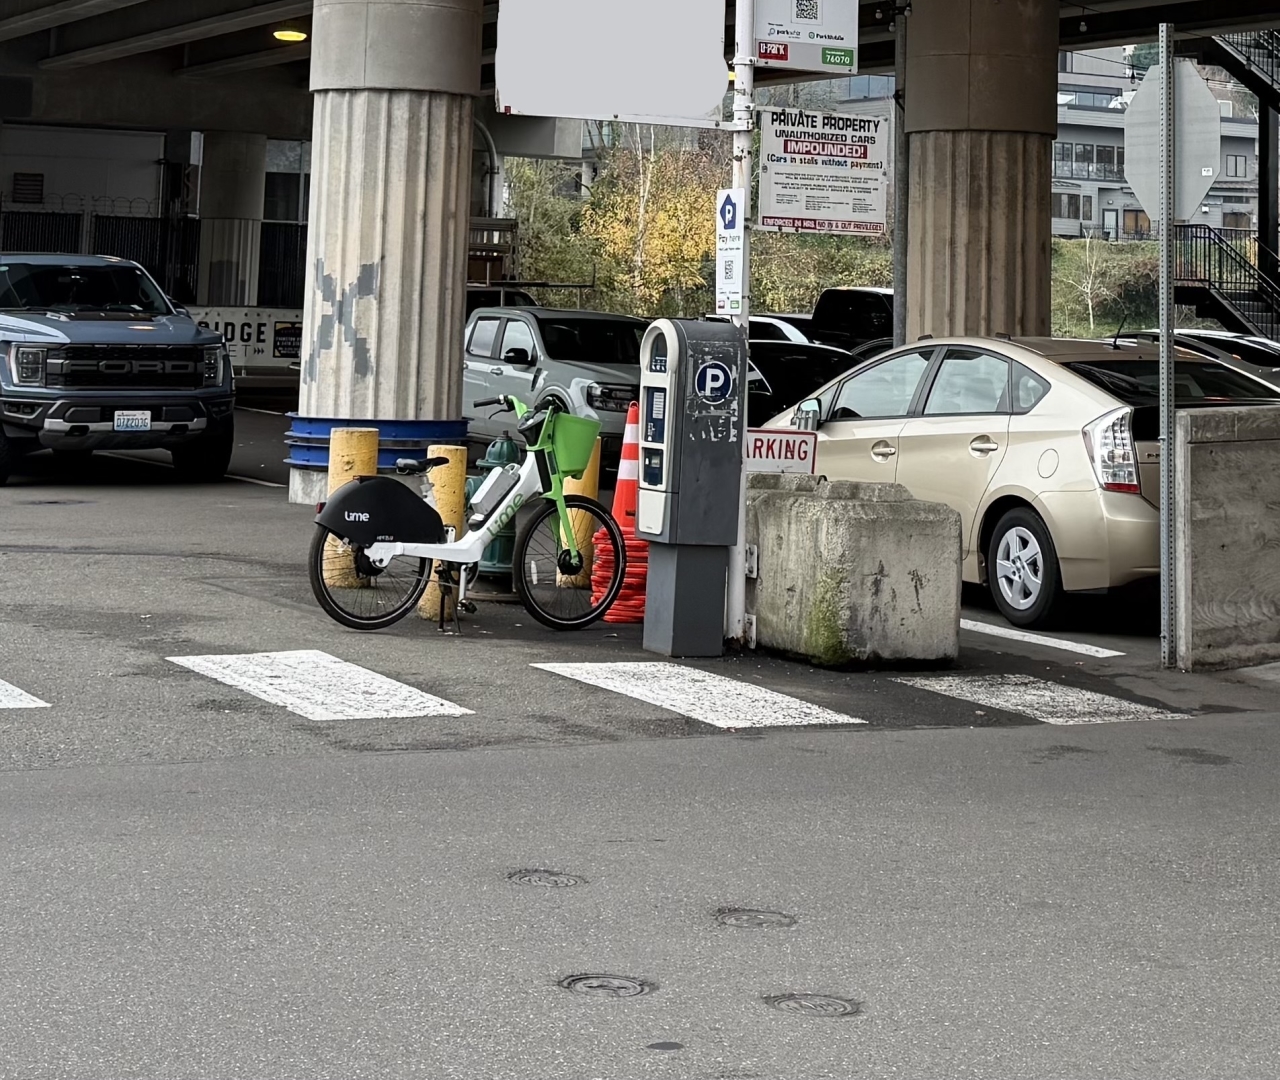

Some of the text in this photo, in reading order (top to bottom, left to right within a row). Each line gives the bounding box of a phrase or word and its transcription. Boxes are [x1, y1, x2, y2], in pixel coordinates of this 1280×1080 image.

[825, 54, 850, 64] 76070
[771, 111, 880, 133] PRIVATE PROPERTY
[775, 129, 876, 145] UNAUTHORIZED CARS
[787, 141, 864, 157] IMPOUNDED!
[767, 153, 788, 163] (Cars
[799, 157, 818, 166] stalls
[821, 158, 848, 167] without
[850, 161, 883, 170] payment)
[725, 204, 733, 225] P
[63, 361, 196, 374] FORD
[706, 368, 725, 396] P
[487, 493, 524, 537] Lime
